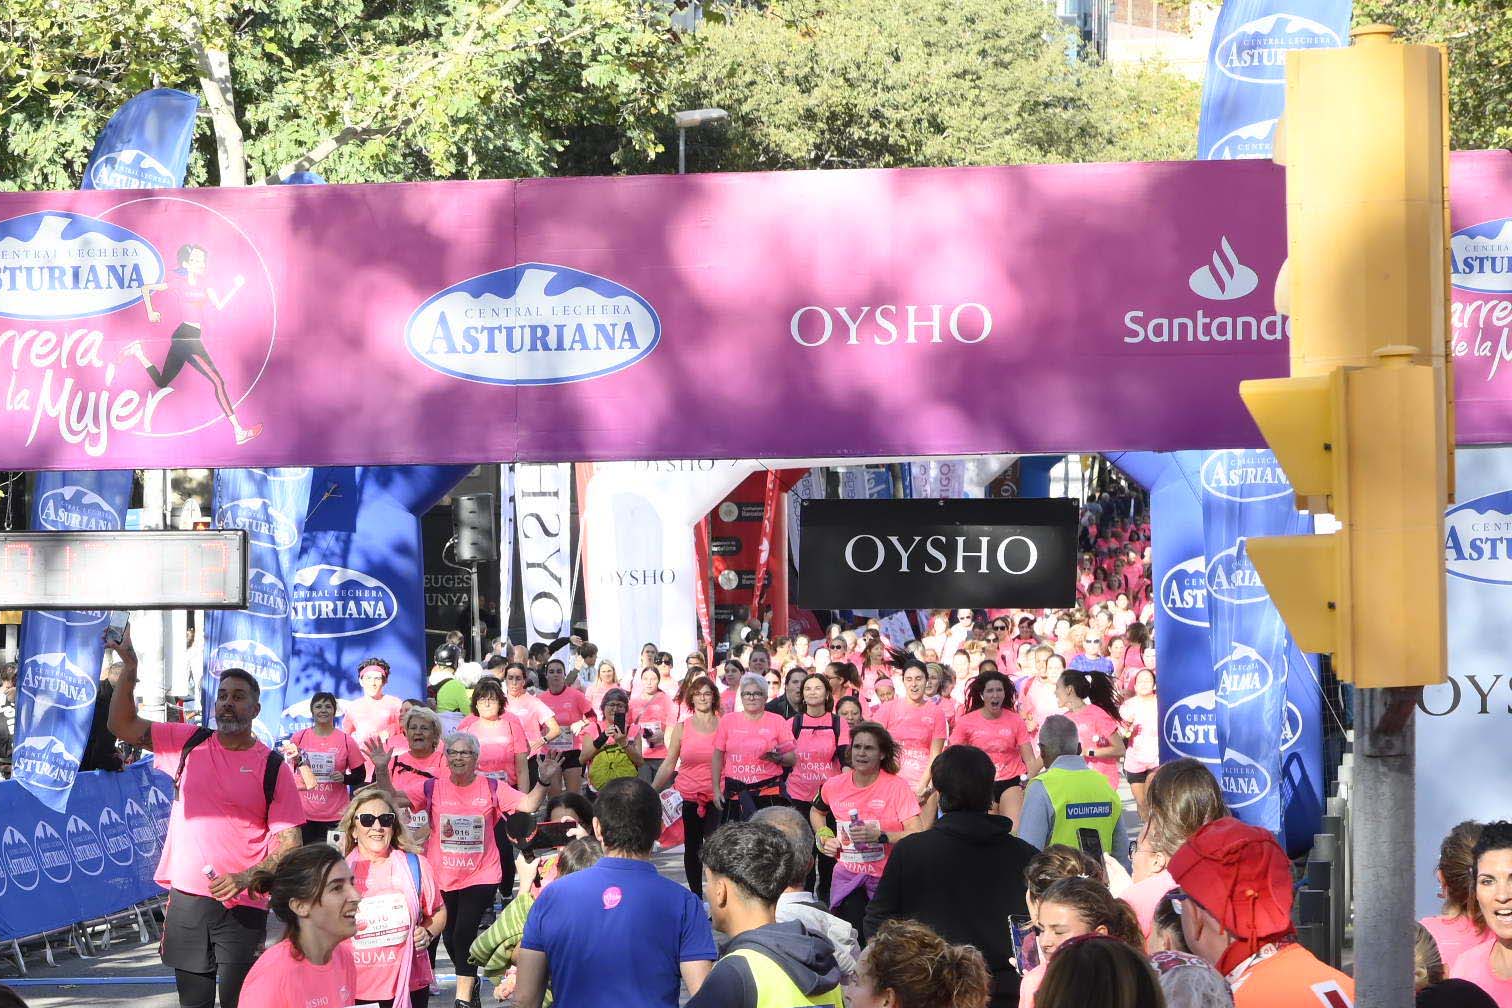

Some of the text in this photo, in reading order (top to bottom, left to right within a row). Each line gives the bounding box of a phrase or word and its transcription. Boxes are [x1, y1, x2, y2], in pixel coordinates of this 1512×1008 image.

[68, 247, 139, 258] LECHERA
[464, 303, 632, 319] CENTRAL LECHERA
[425, 310, 642, 354] ASTURIANA
[790, 303, 993, 347] OYSHO
[7, 371, 30, 411] la
[25, 364, 176, 457] Mujer
[844, 534, 1039, 575] OYSHO
[292, 590, 330, 599] ENTRAL
[290, 600, 388, 620] STURIANA
[731, 754, 742, 762] TU
[799, 752, 810, 760] TU
[1067, 805, 1110, 816] VOLUNTARIS
[442, 856, 475, 867] SUMA
[353, 949, 397, 963] SUMA
